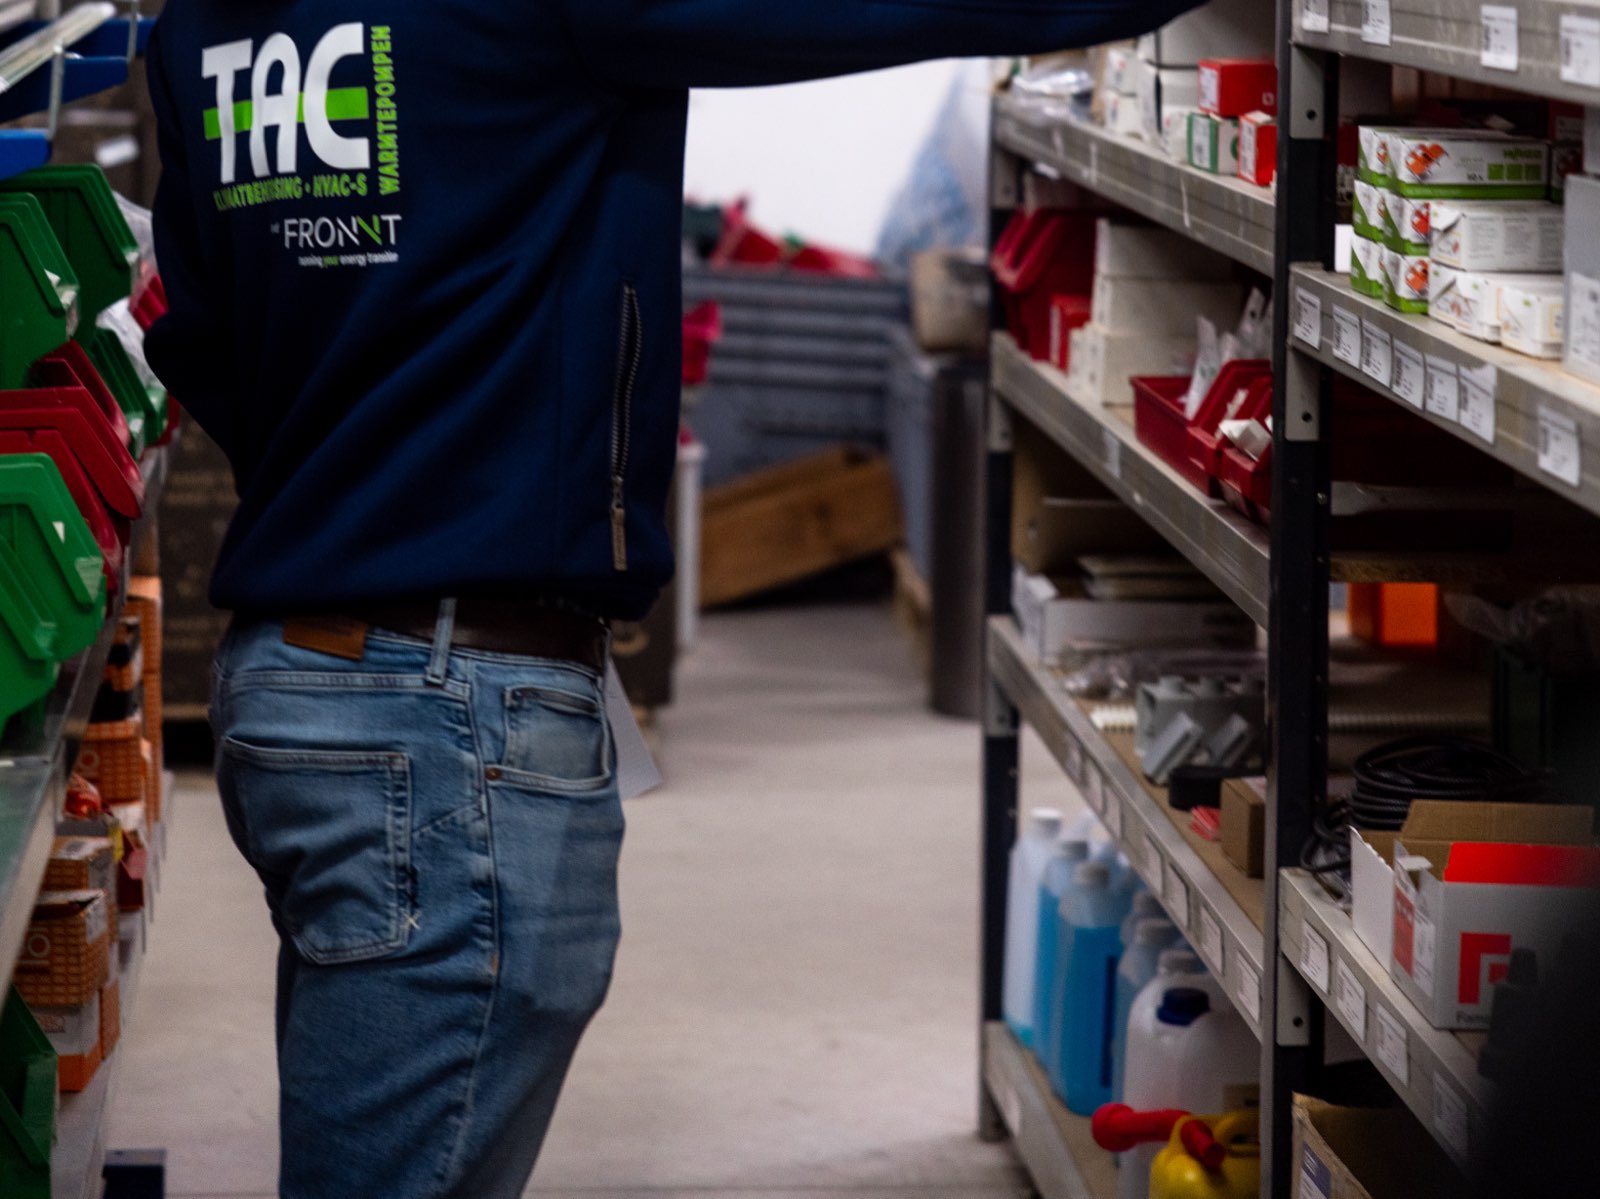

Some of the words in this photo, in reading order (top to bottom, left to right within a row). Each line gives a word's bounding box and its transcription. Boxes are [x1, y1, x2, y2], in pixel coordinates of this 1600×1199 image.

[202, 22, 370, 184] TAC
[371, 26, 400, 195] WARMTEPOMPEN
[284, 213, 402, 249] FRONNT
